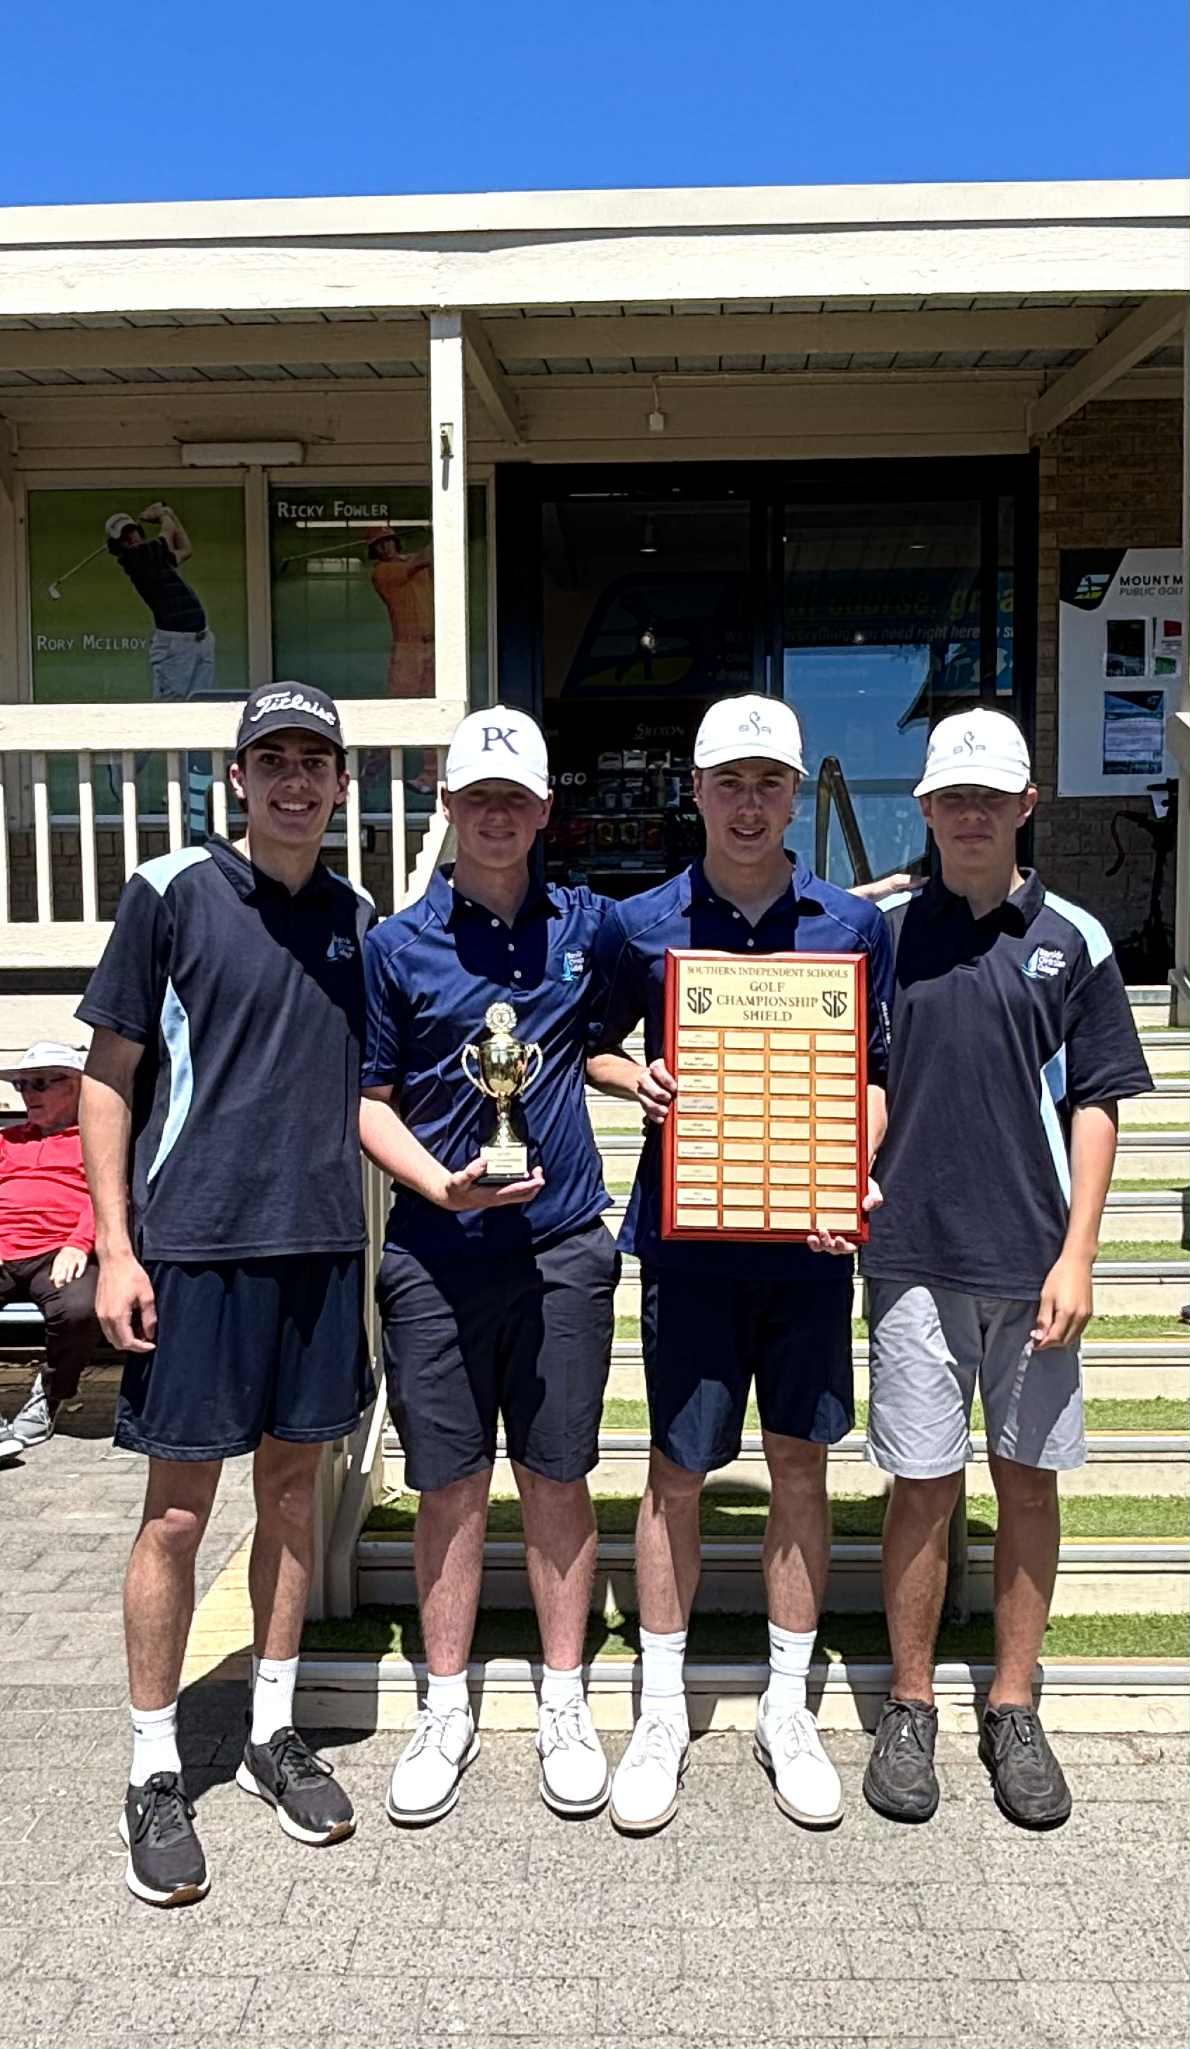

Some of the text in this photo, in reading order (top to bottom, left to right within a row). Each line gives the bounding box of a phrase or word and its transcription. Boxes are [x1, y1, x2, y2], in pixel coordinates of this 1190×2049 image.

[1120, 575, 1169, 586] MOUNT
[481, 726, 520, 755] PK
[687, 966, 849, 979] SOUTHERN INDEPENDENT SCHOOLS
[749, 981, 786, 993] GOLF
[716, 994, 819, 1008] CHAMPIONSHIP
[743, 1009, 793, 1022] SHIELD
